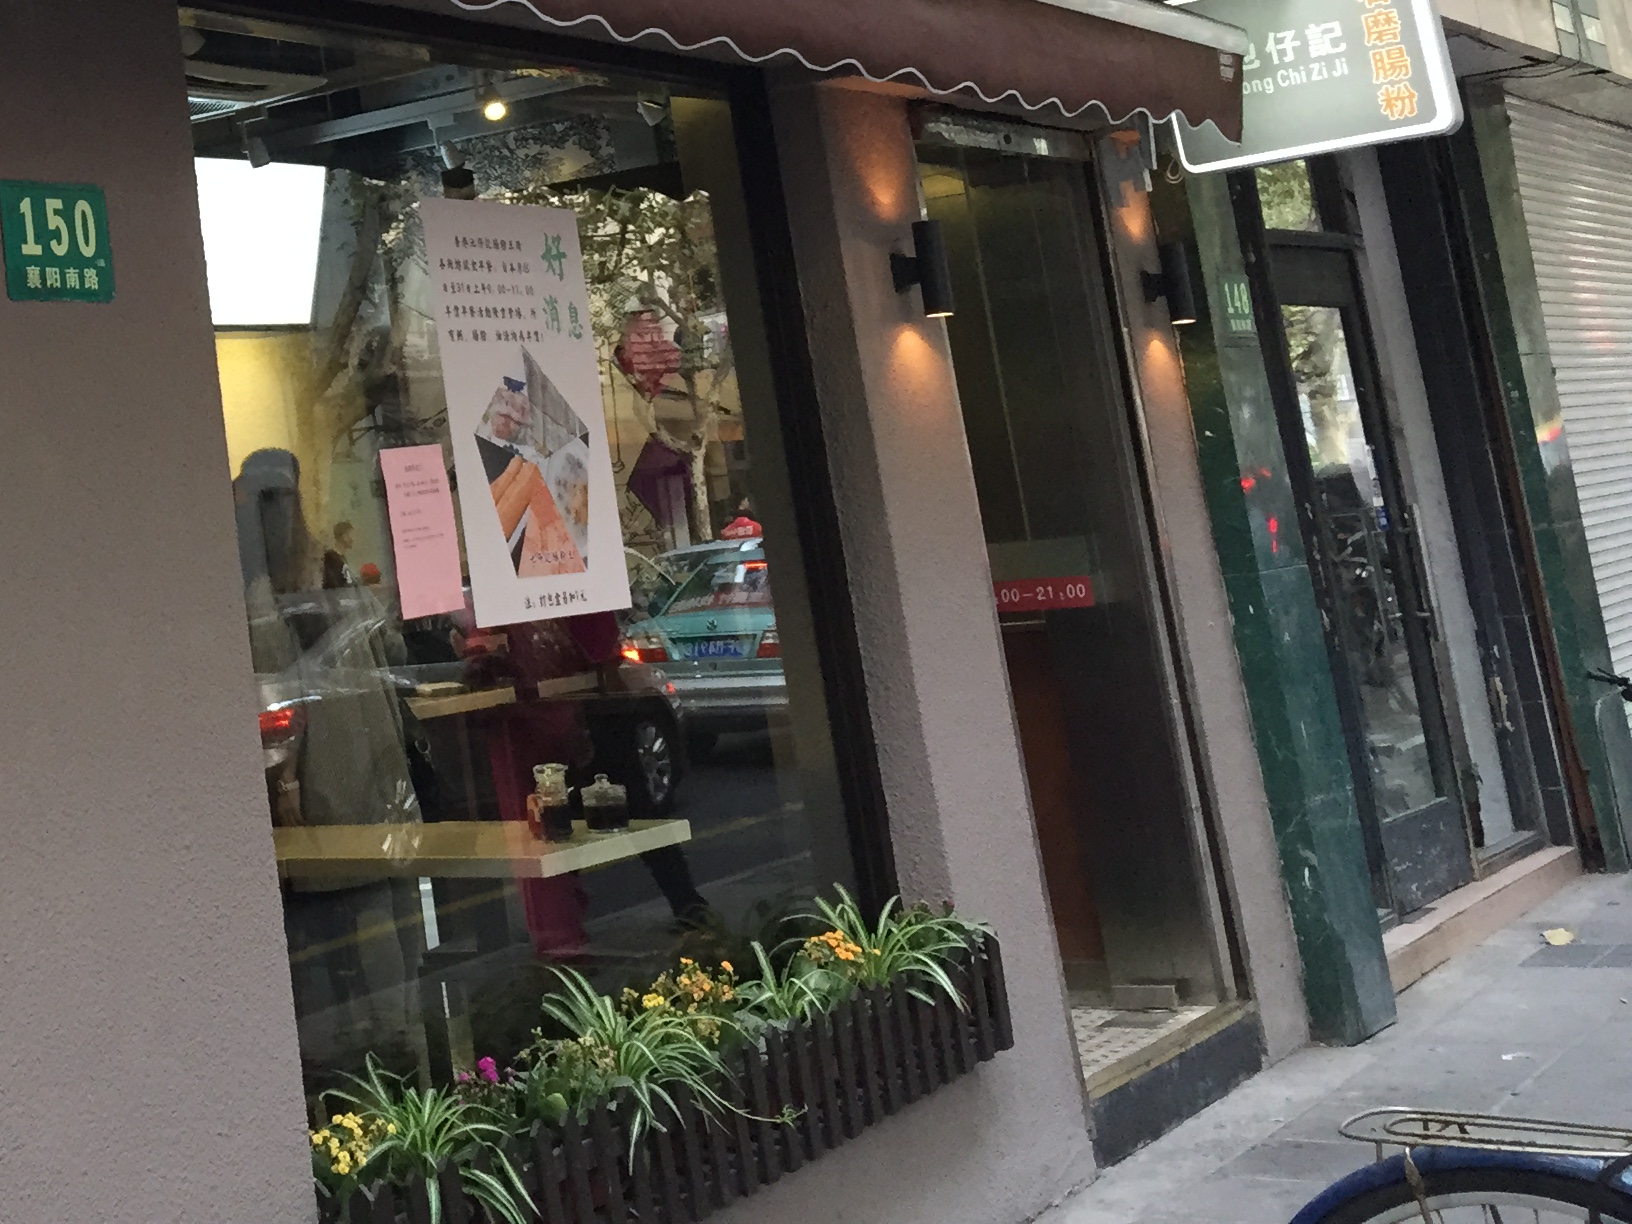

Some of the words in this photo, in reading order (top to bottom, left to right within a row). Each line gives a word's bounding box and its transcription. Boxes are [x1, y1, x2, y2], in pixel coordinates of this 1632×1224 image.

[1243, 76, 1274, 95] ong
[1277, 65, 1308, 88] Chi
[1308, 61, 1329, 82] Zi
[1331, 57, 1349, 78] Ji
[19, 196, 97, 258] 150
[25, 265, 99, 290] 襄阳南路
